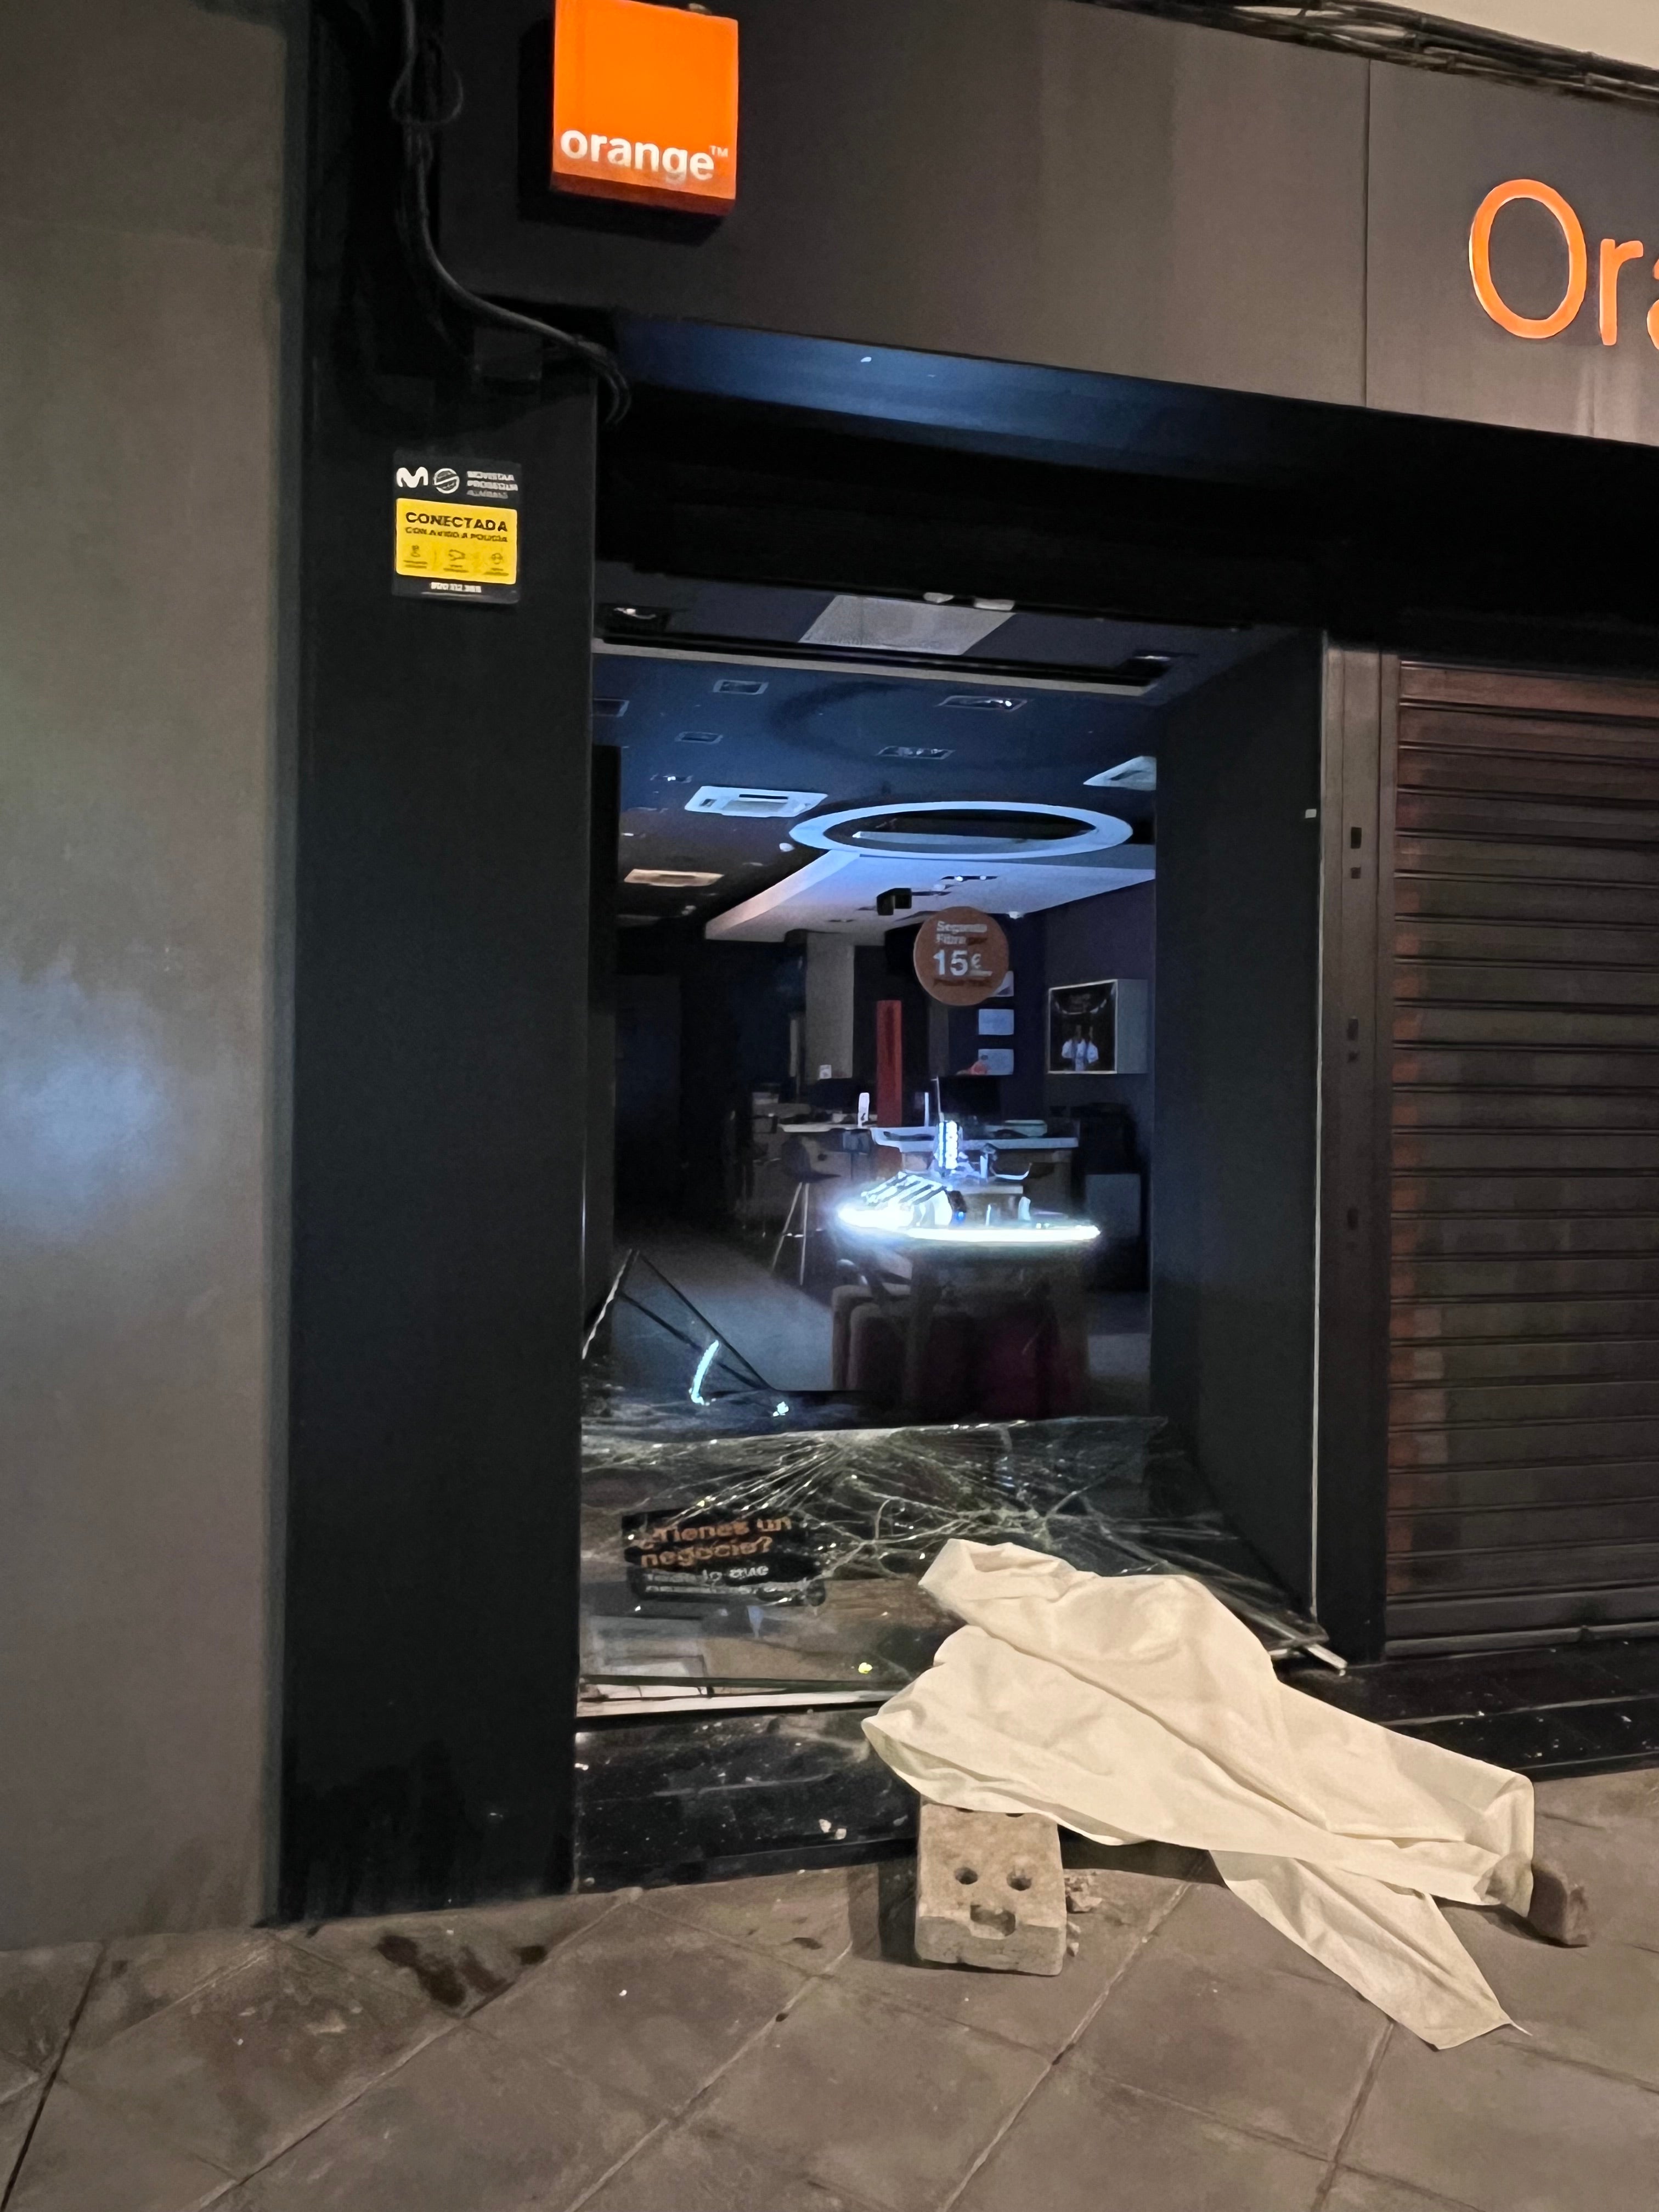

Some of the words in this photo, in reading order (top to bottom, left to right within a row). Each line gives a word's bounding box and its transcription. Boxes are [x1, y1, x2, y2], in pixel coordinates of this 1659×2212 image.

[560, 129, 714, 185] orange
[1468, 178, 1659, 350] Or
[405, 512, 508, 532] CONECTADA
[405, 527, 427, 535] CON
[757, 1516, 792, 1532] un
[640, 1536, 773, 1567] negocio?
